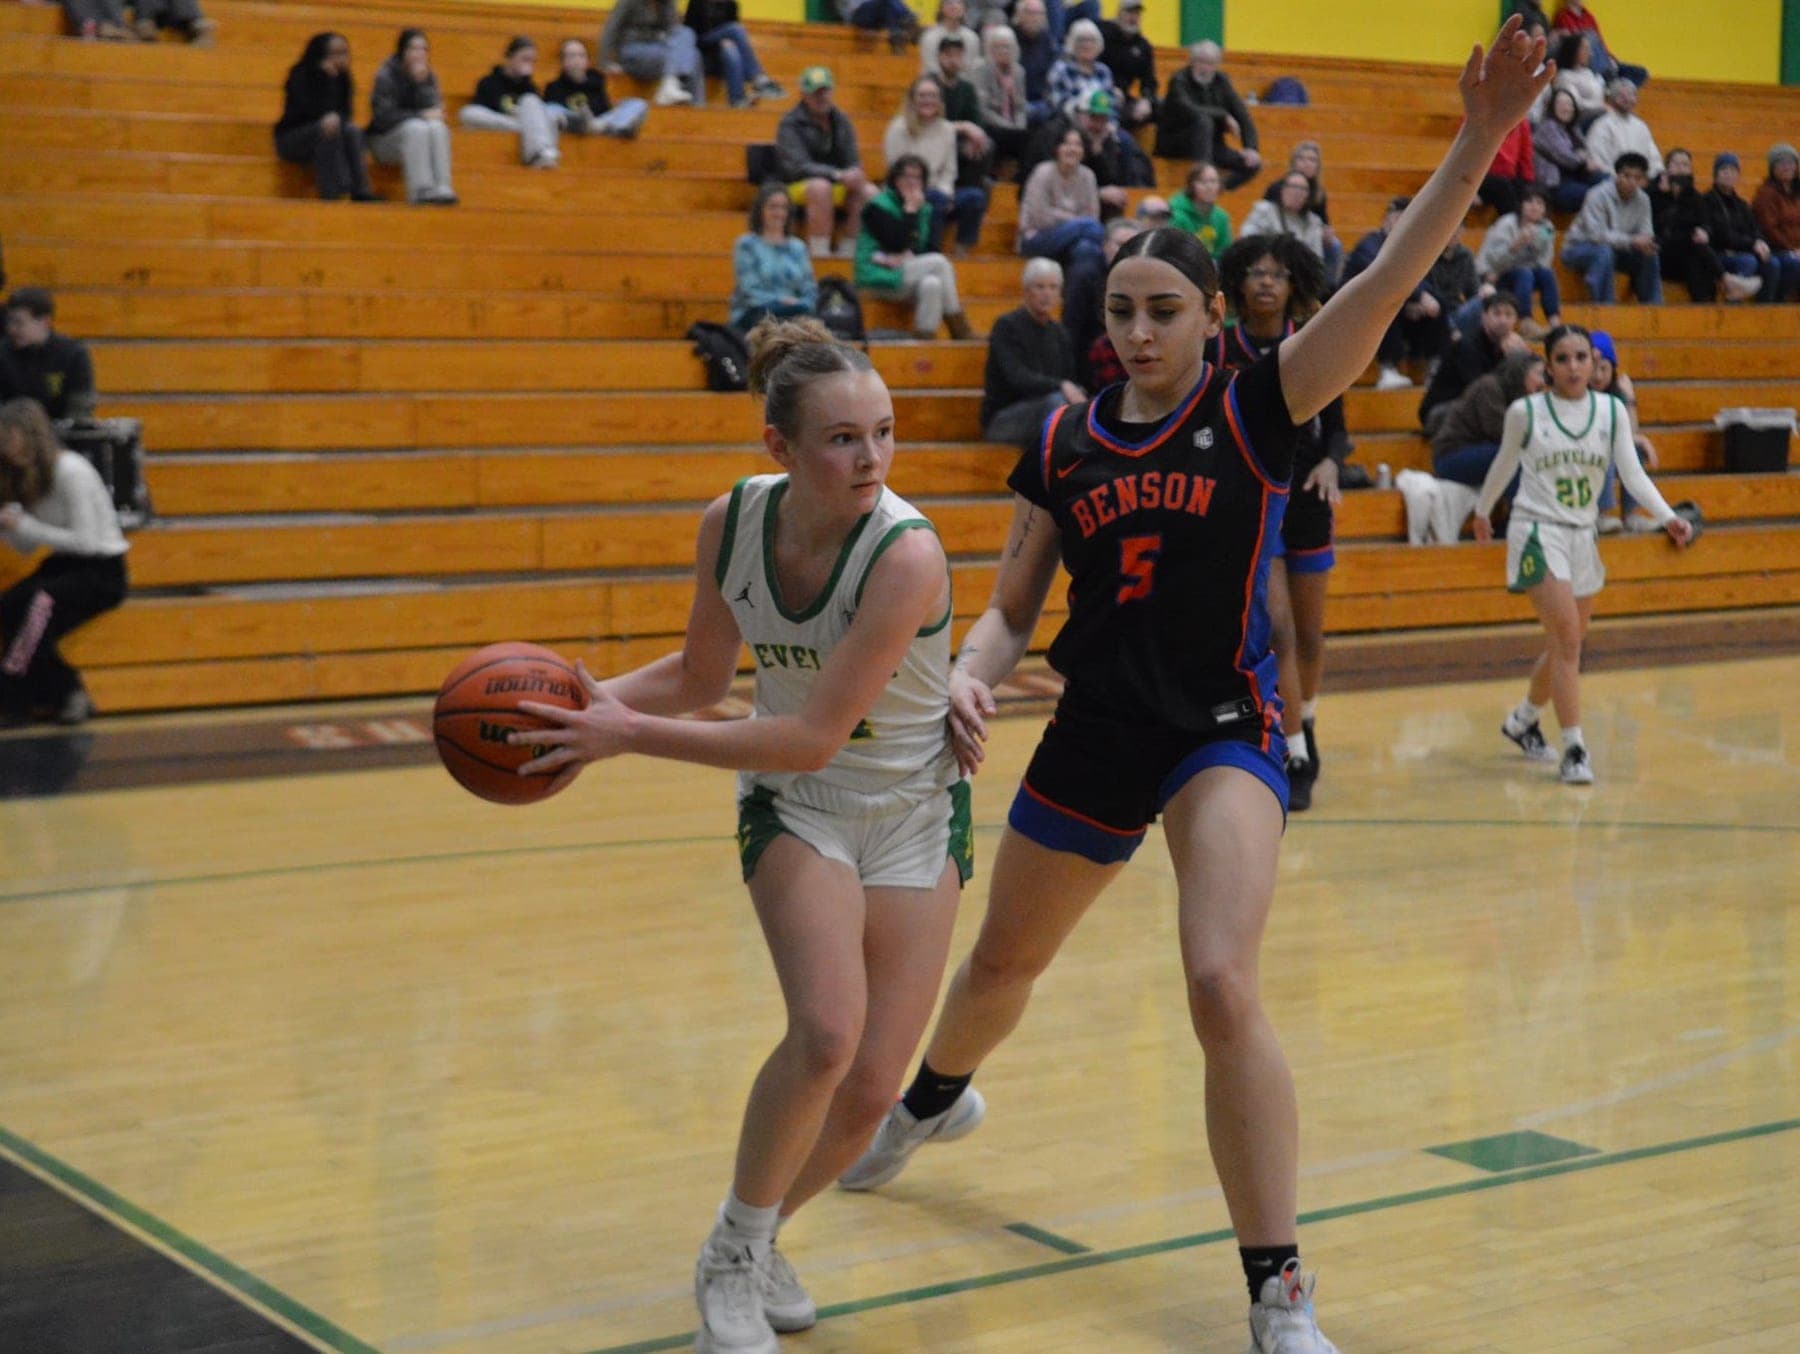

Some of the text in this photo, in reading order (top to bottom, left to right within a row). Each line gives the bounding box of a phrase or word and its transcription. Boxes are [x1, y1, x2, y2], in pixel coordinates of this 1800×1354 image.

[1535, 449, 1607, 472] CLEVELAN
[1071, 471, 1217, 539] BENSON
[1555, 476, 1592, 507] 20
[1117, 535, 1162, 605] 5
